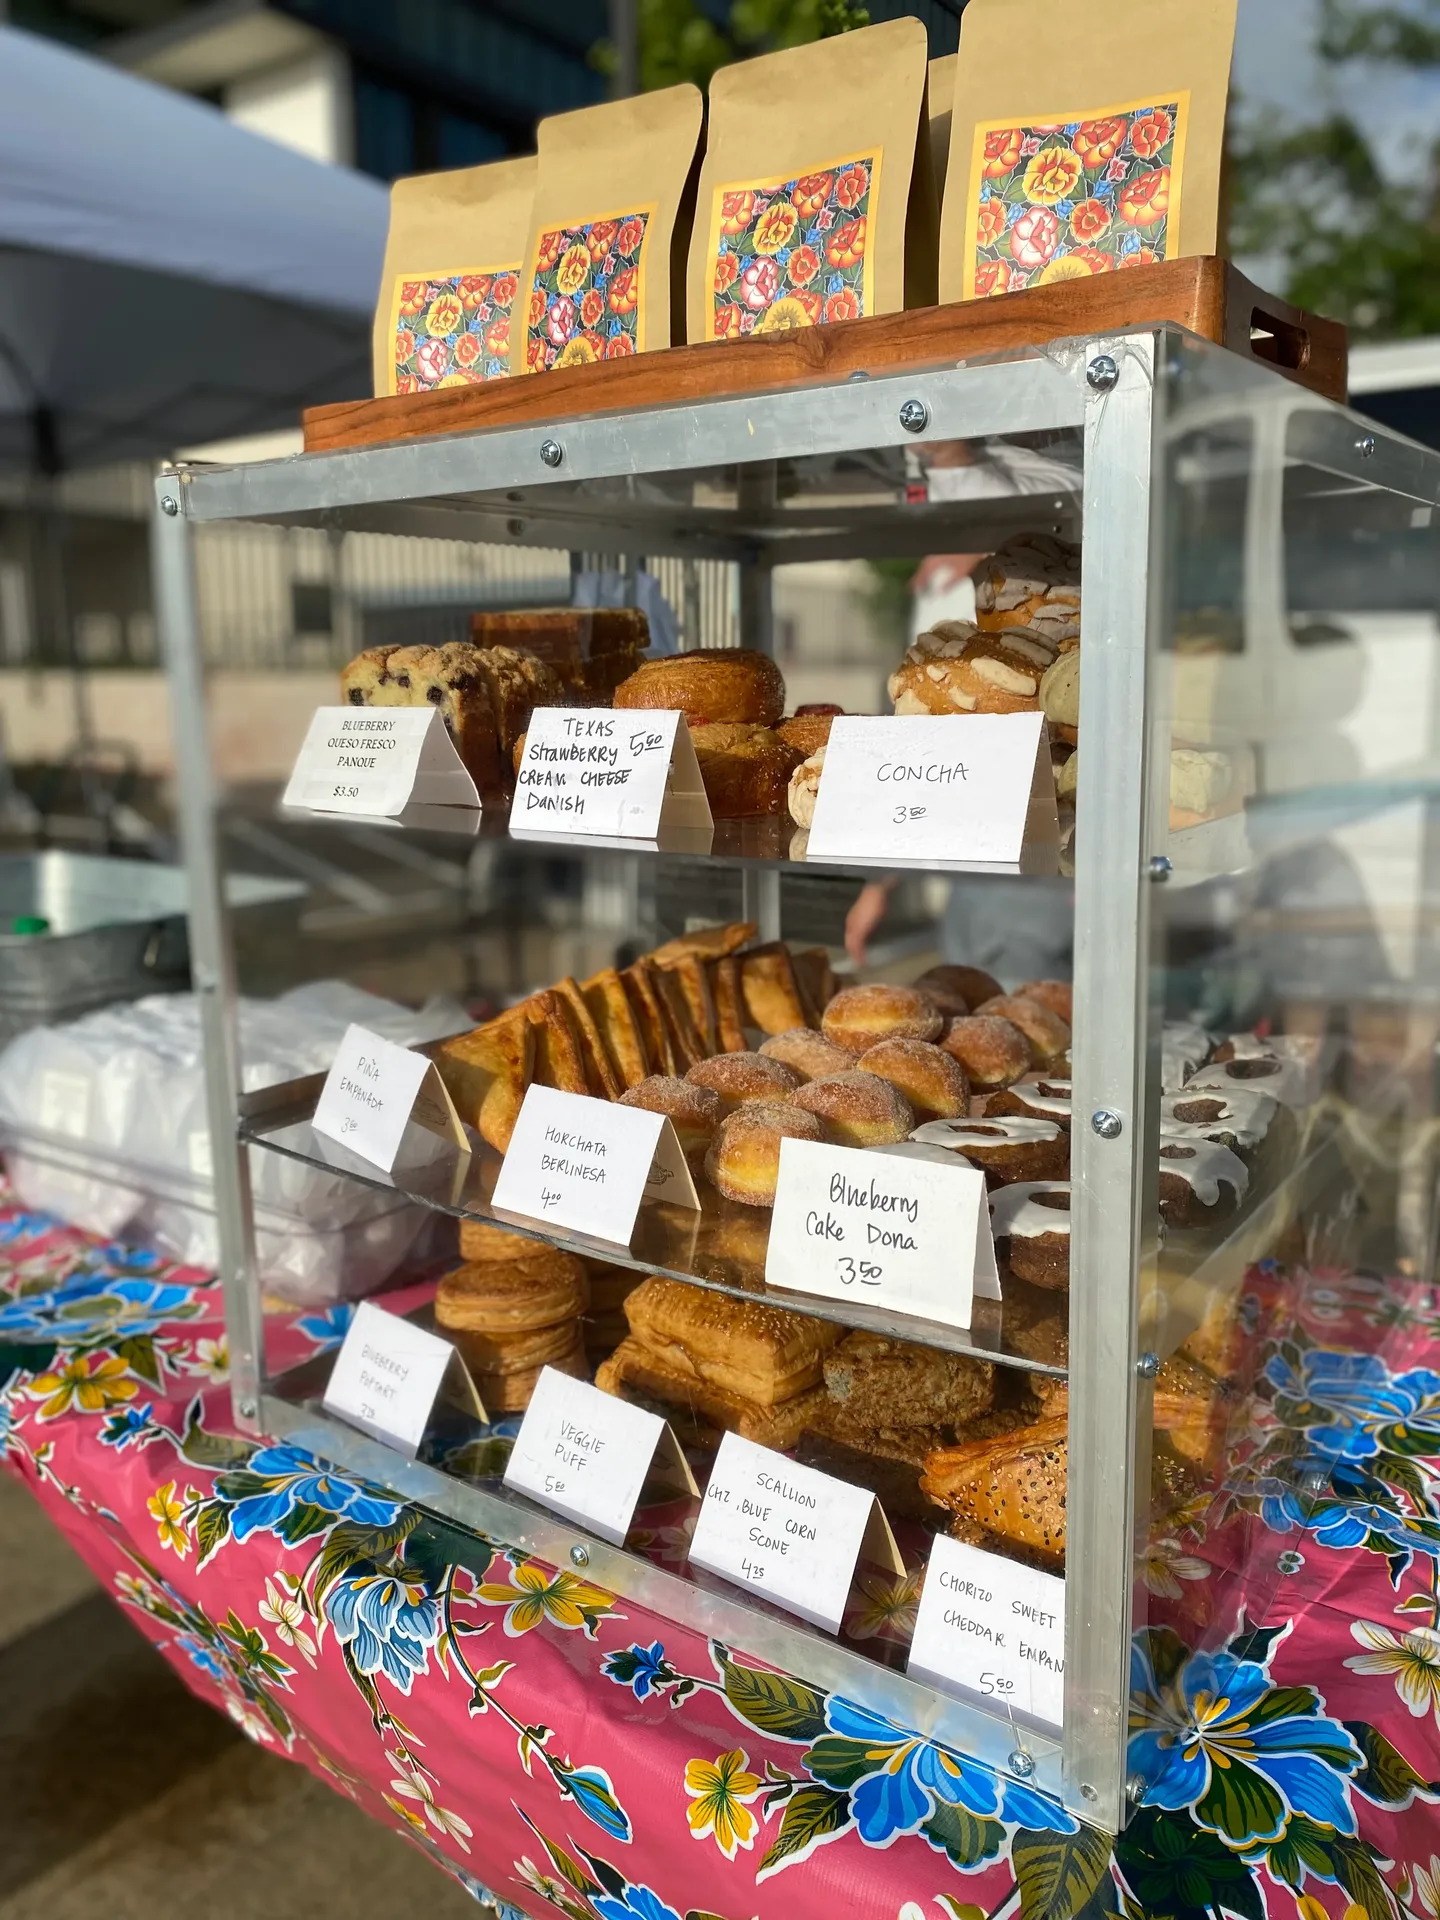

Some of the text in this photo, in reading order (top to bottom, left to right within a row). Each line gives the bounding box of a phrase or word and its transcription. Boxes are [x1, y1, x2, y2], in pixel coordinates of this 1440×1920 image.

[342, 720, 396, 731] BLUEBERRY
[563, 717, 615, 737] TEXAS
[327, 738, 396, 749] QUESO FRESCO
[337, 756, 376, 767] PANQUE
[877, 762, 969, 783] CONCHA
[333, 785, 359, 797] $3.50
[580, 769, 632, 786] CHEESE
[356, 1056, 380, 1081] PIÑA
[340, 1076, 384, 1111] EMPANADA
[544, 1125, 607, 1157] HORCHATA
[541, 1154, 606, 1183] BERLINESA
[830, 1172, 918, 1222] Blueberry
[806, 1211, 918, 1250] Cake Dona
[561, 1420, 605, 1453] VEGGIE
[555, 1443, 587, 1471] PUFF
[756, 1473, 816, 1509] SCALLION
[749, 1527, 790, 1555] SCONE
[785, 1519, 816, 1541] CORN
[939, 1571, 1056, 1629] CHORIZO SWEET
[943, 1609, 1006, 1648] CHEDDAR
